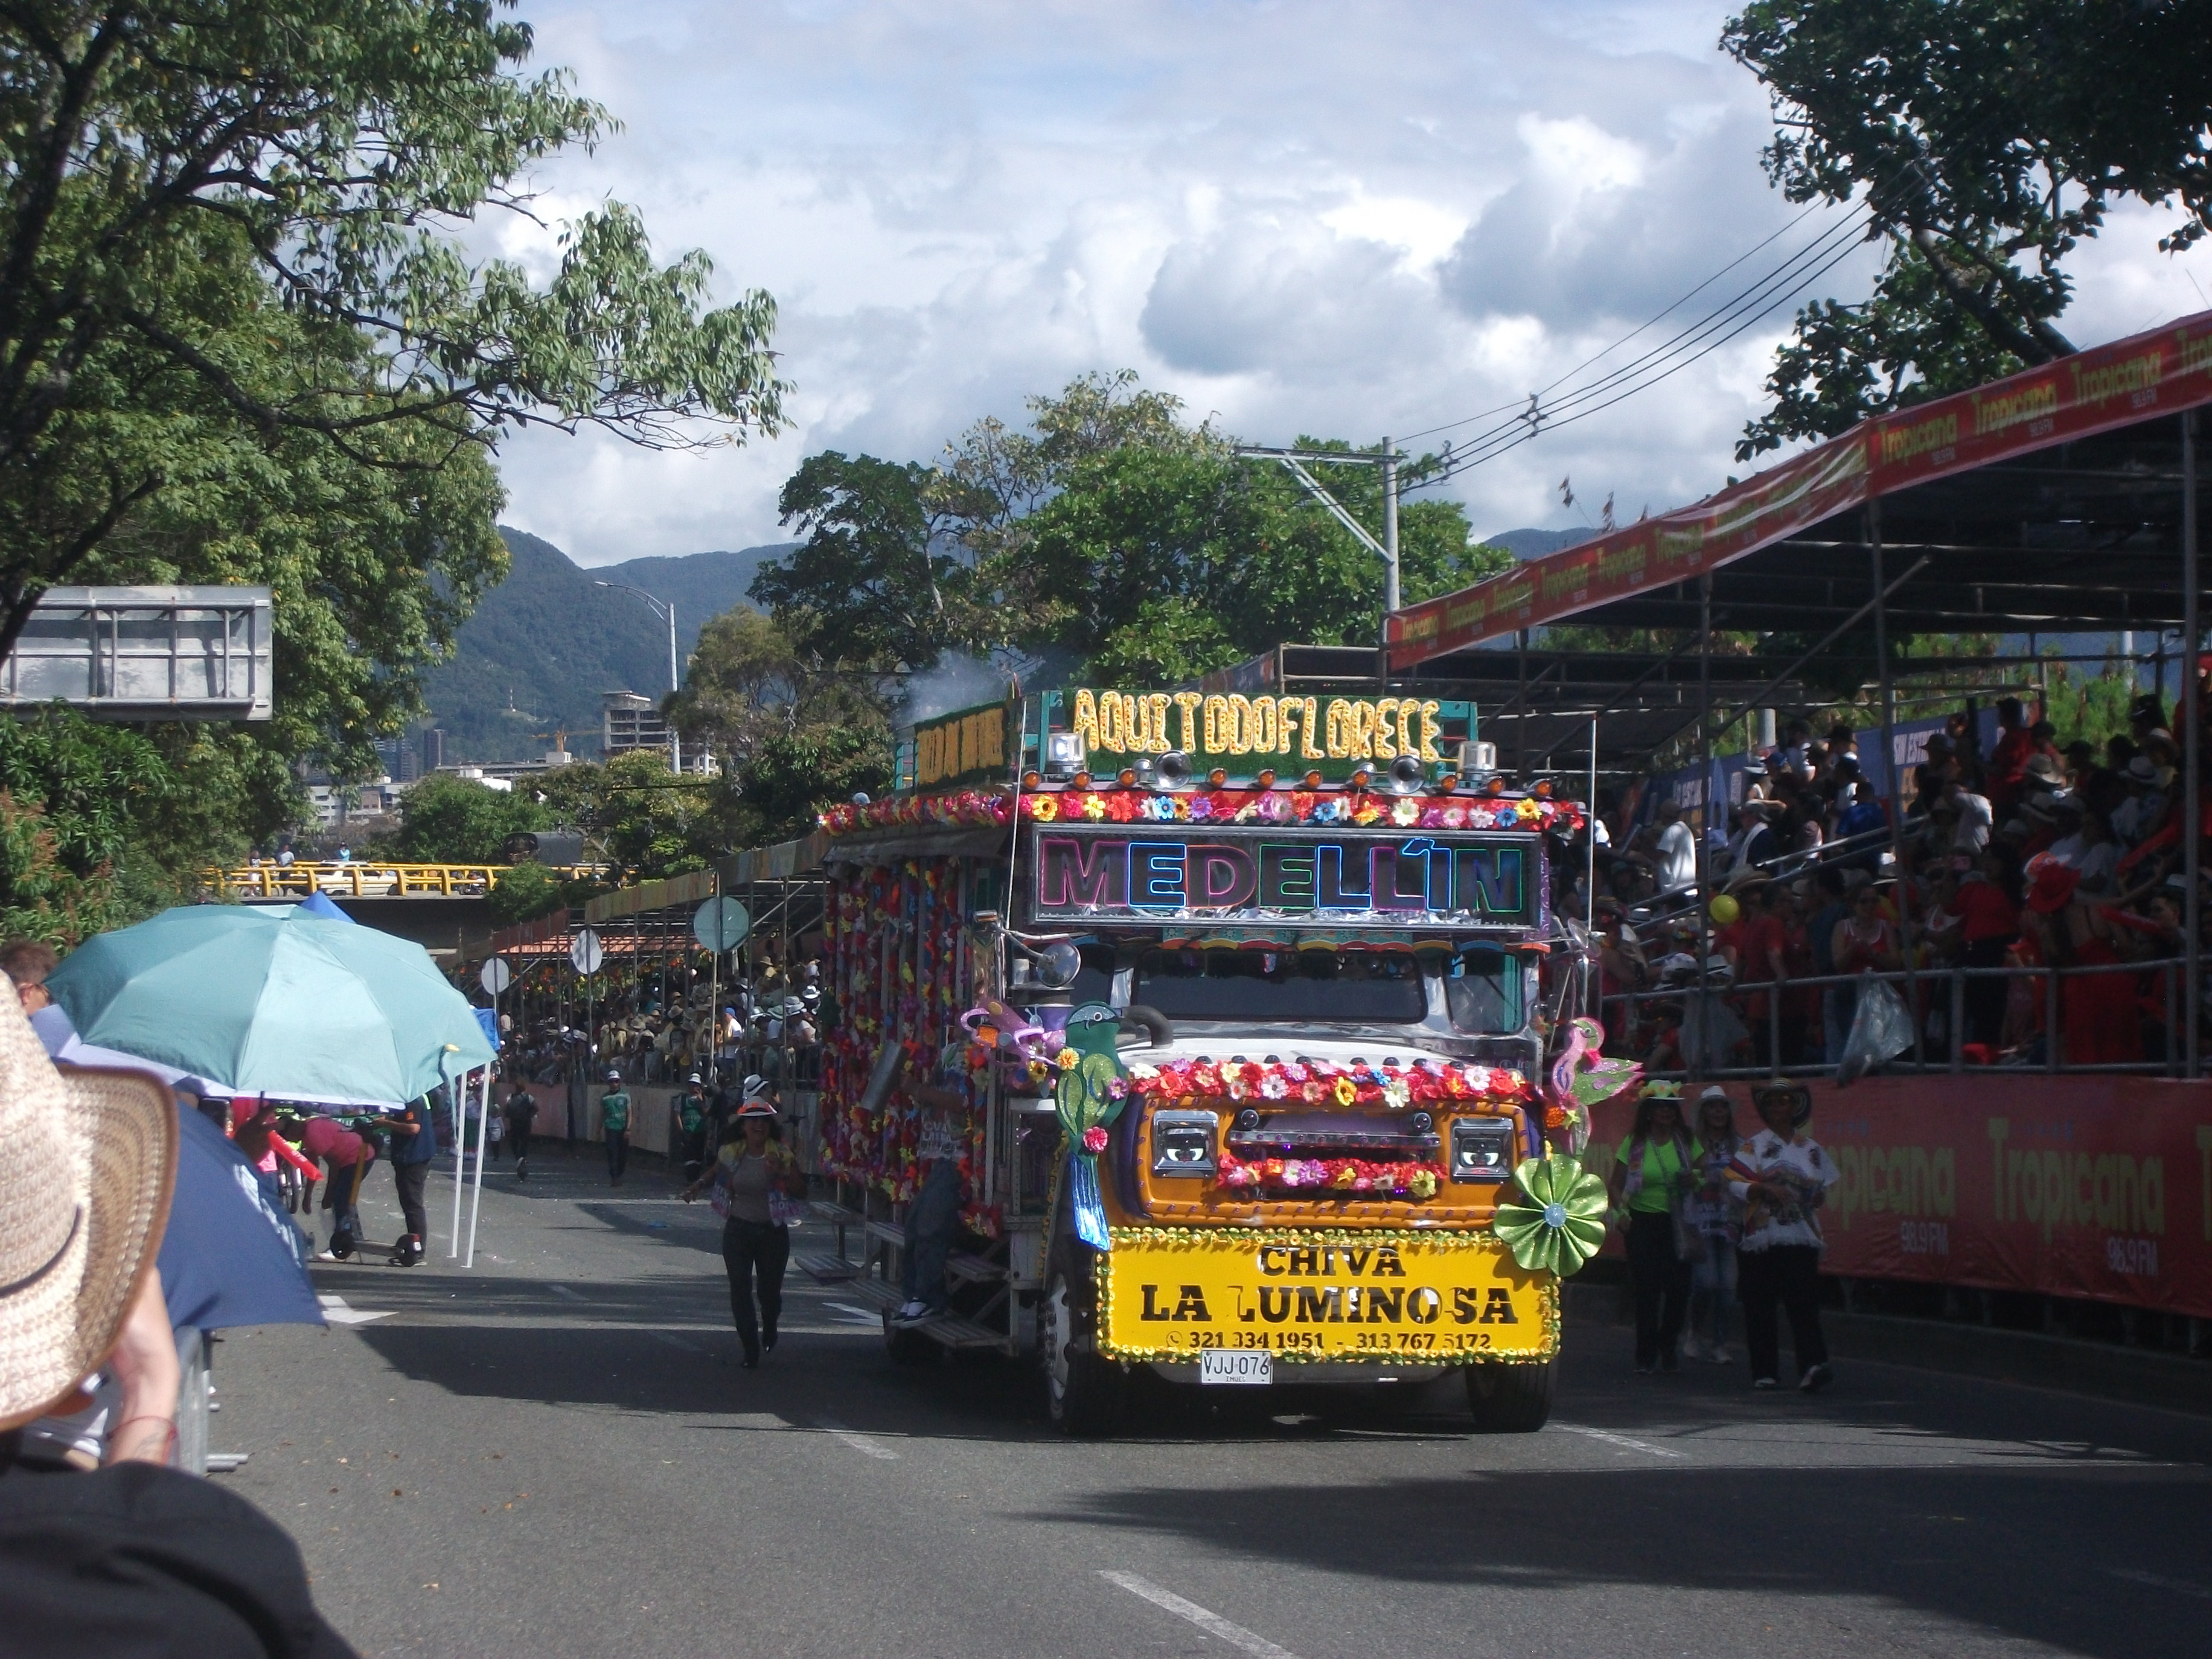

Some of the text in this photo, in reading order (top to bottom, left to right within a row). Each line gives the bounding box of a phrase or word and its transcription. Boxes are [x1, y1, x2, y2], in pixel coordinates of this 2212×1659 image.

[2071, 350, 2161, 409] Tropicana
[1971, 382, 2056, 437] Tropicana
[1878, 414, 1957, 466] Tropicana
[1987, 1117, 2166, 1244] Tropicana
[1260, 1245, 1406, 1277] CHIVA
[1141, 1285, 1518, 1325] LA LUMINOSA
[1190, 1331, 1224, 1348] 321
[1276, 1332, 1324, 1349] 1951
[1356, 1333, 1391, 1350] 313
[1399, 1334, 1435, 1350] 767
